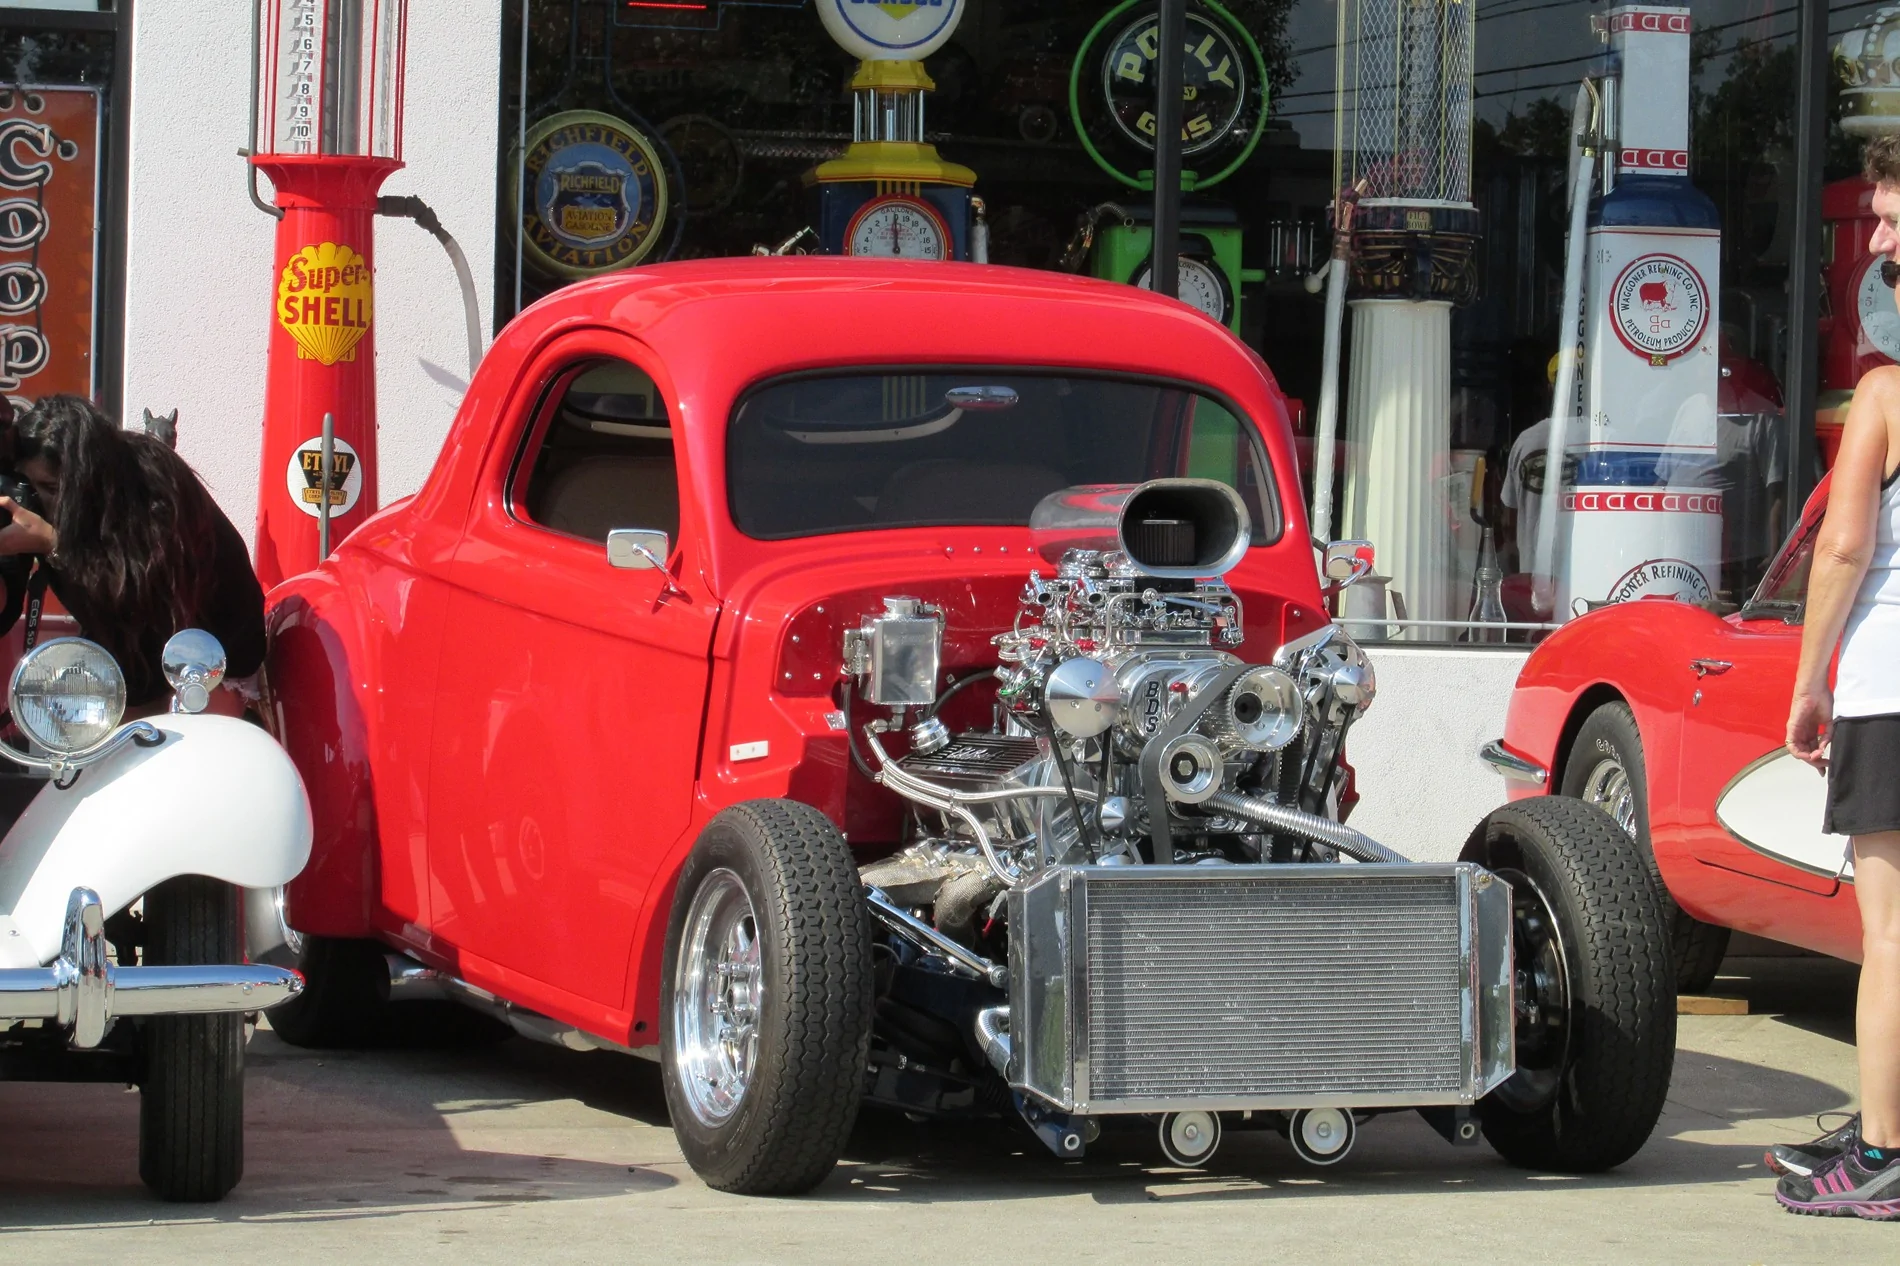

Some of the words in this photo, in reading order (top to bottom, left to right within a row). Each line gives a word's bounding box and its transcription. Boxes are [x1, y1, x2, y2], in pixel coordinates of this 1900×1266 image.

[305, 14, 314, 26] 5
[303, 38, 313, 50] 6
[303, 61, 312, 71] 7
[1116, 26, 1235, 89] POLY
[301, 83, 310, 95] 8
[299, 106, 309, 118] 9
[295, 125, 309, 137] 10
[1136, 111, 1212, 140] GS
[526, 125, 649, 176] RICHFIELD
[560, 174, 620, 194] RICHFIELD
[565, 221, 612, 231] GASOLINE
[566, 209, 612, 221] AVIATION
[523, 213, 649, 266] AVIATION
[287, 256, 368, 293] Super
[1621, 268, 1648, 312] WAGGONER
[1647, 263, 1684, 281] REFNING
[283, 295, 367, 329] SHELL
[1625, 319, 1662, 348] PETROLEUM
[1664, 318, 1696, 347] PRODUCTS
[302, 452, 350, 473] ETYL
[1651, 565, 1701, 589] REFINING
[29, 599, 40, 628] EOS
[1145, 681, 1160, 733] BDS
